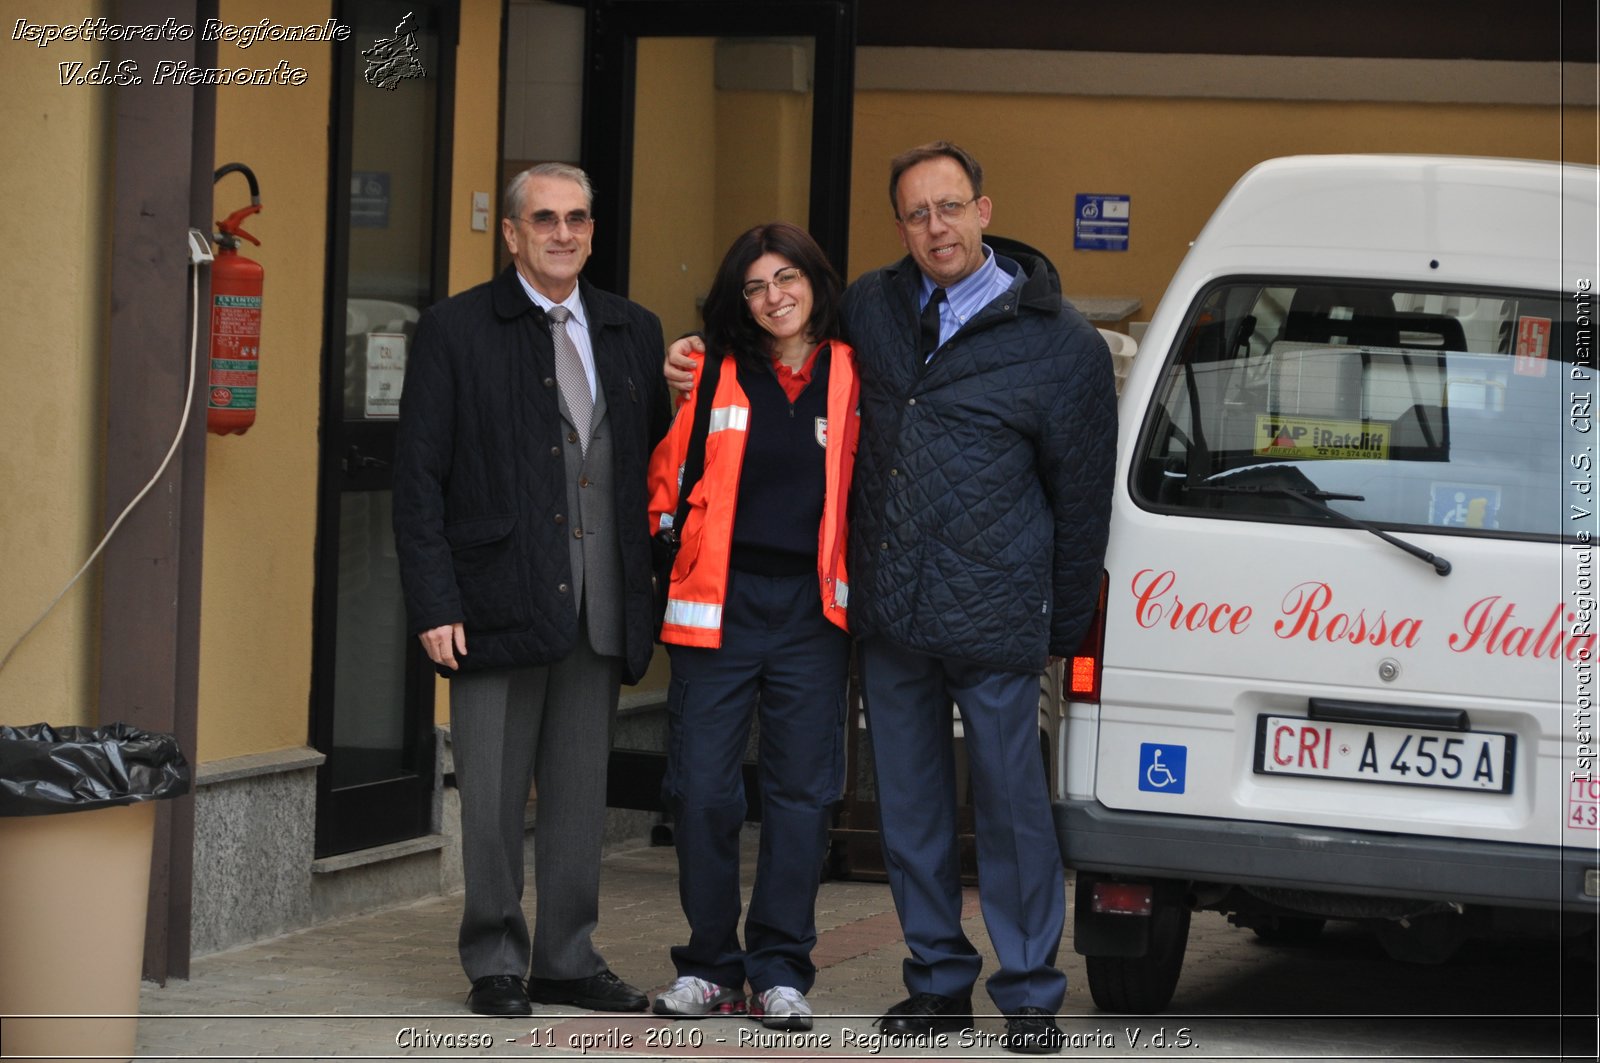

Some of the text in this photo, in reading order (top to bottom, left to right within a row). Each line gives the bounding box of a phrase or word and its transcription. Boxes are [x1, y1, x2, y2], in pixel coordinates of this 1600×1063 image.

[1262, 423, 1307, 440] TAP
[1320, 429, 1384, 452] Ratcliff
[1131, 568, 1253, 635] Croce
[1274, 581, 1423, 649] Rossa
[1273, 725, 1332, 770] CRI
